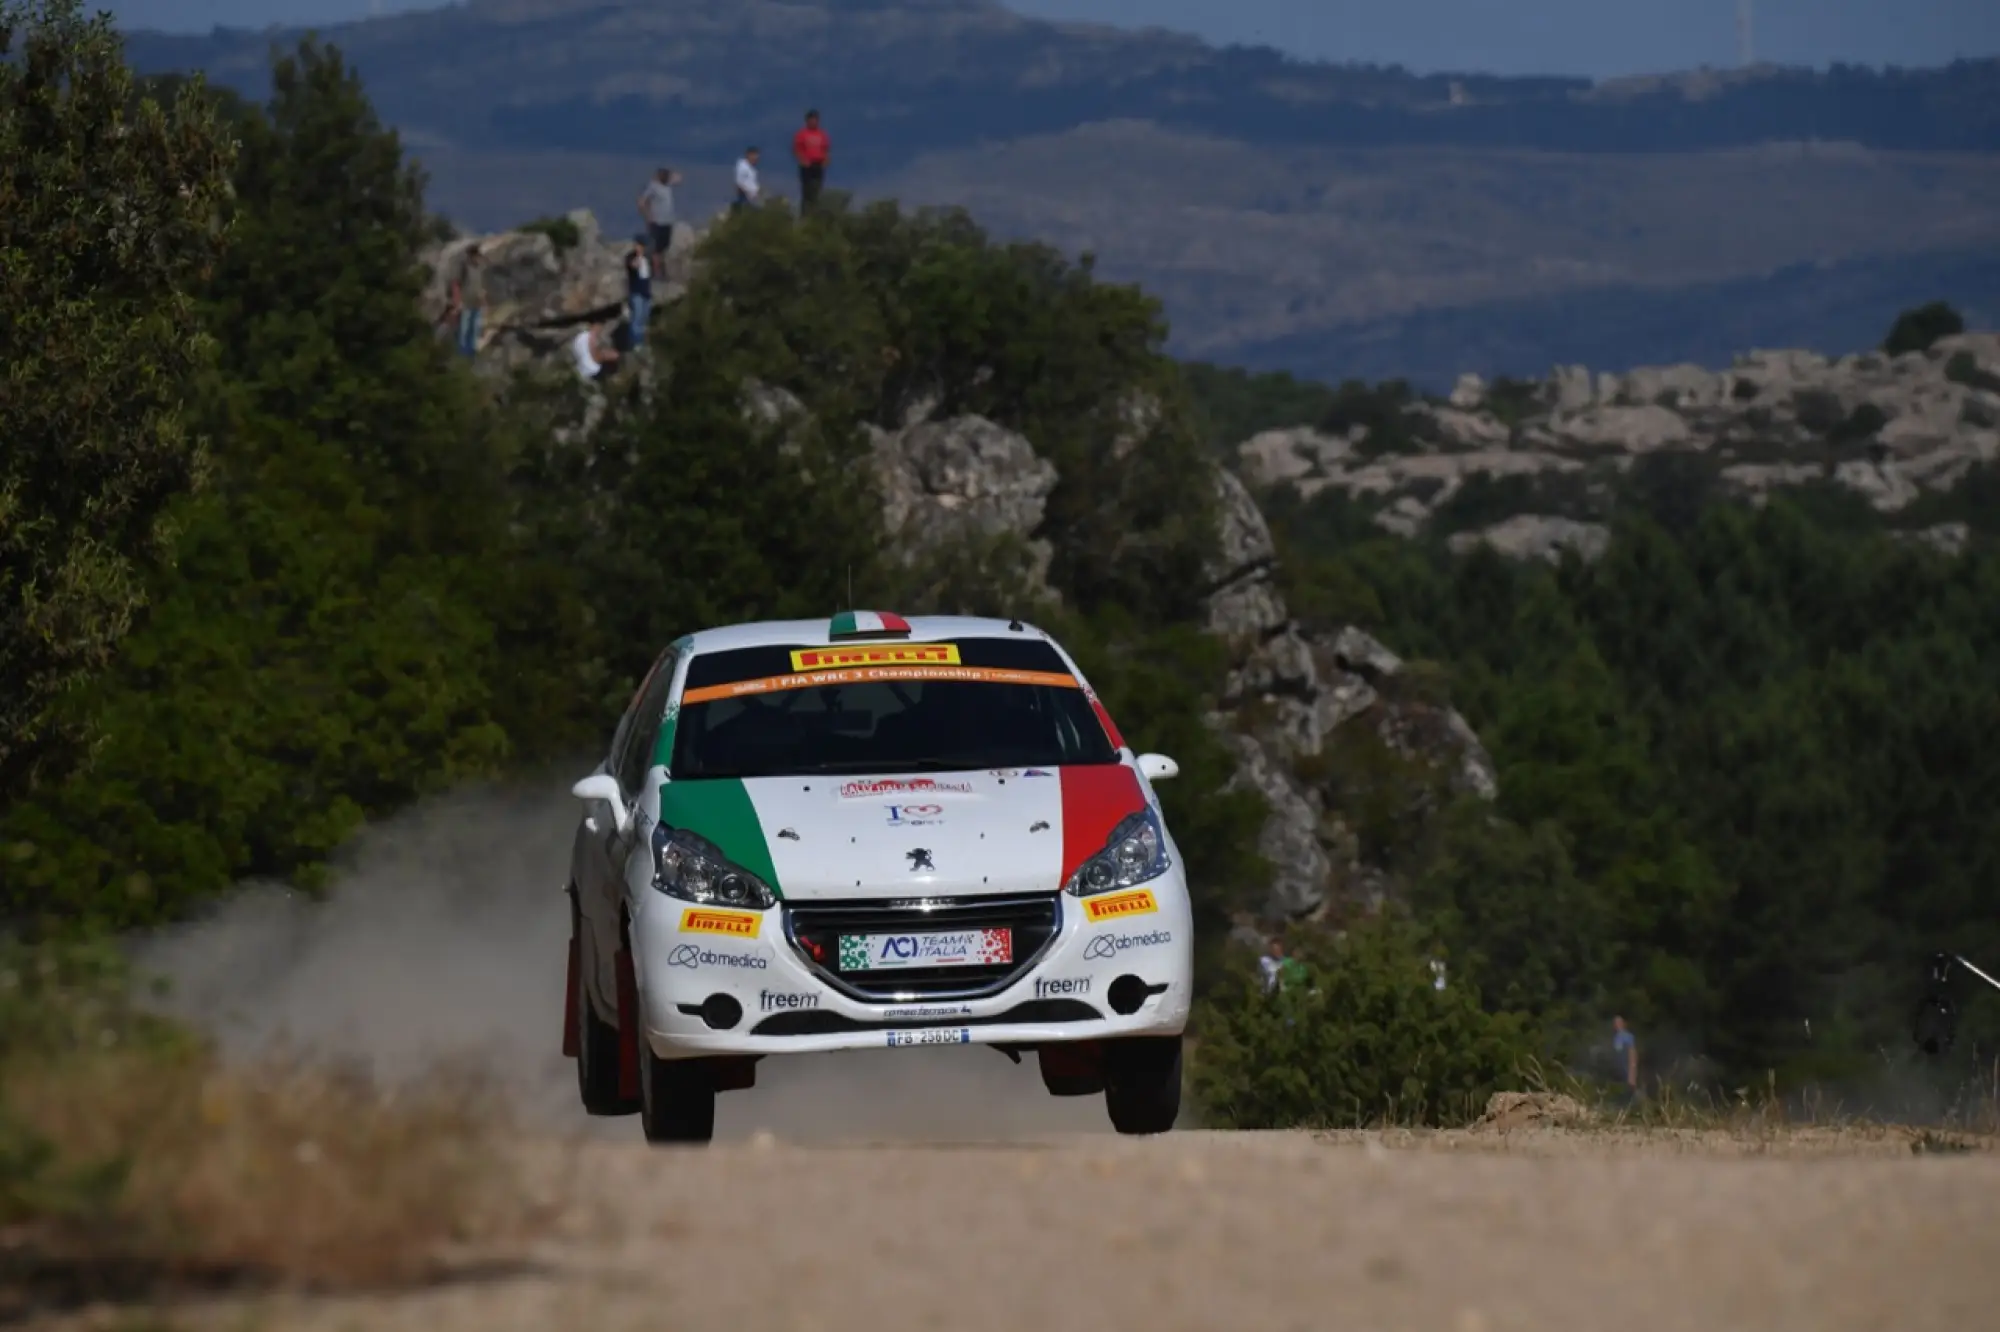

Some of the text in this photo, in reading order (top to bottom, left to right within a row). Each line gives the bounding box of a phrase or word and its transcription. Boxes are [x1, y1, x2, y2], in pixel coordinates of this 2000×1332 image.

[800, 646, 948, 666] PIRELLI
[781, 675, 808, 689] FIA
[812, 670, 849, 683] WRC
[855, 670, 863, 680] 3
[868, 666, 981, 680] Championship
[1089, 892, 1152, 916] PIRELLI
[686, 911, 754, 933] PIRELLI
[881, 936, 918, 958] ACI
[918, 945, 968, 957] ITALIA
[922, 935, 962, 947] TEAM
[1035, 977, 1090, 996] freem
[760, 989, 818, 1011] freem
